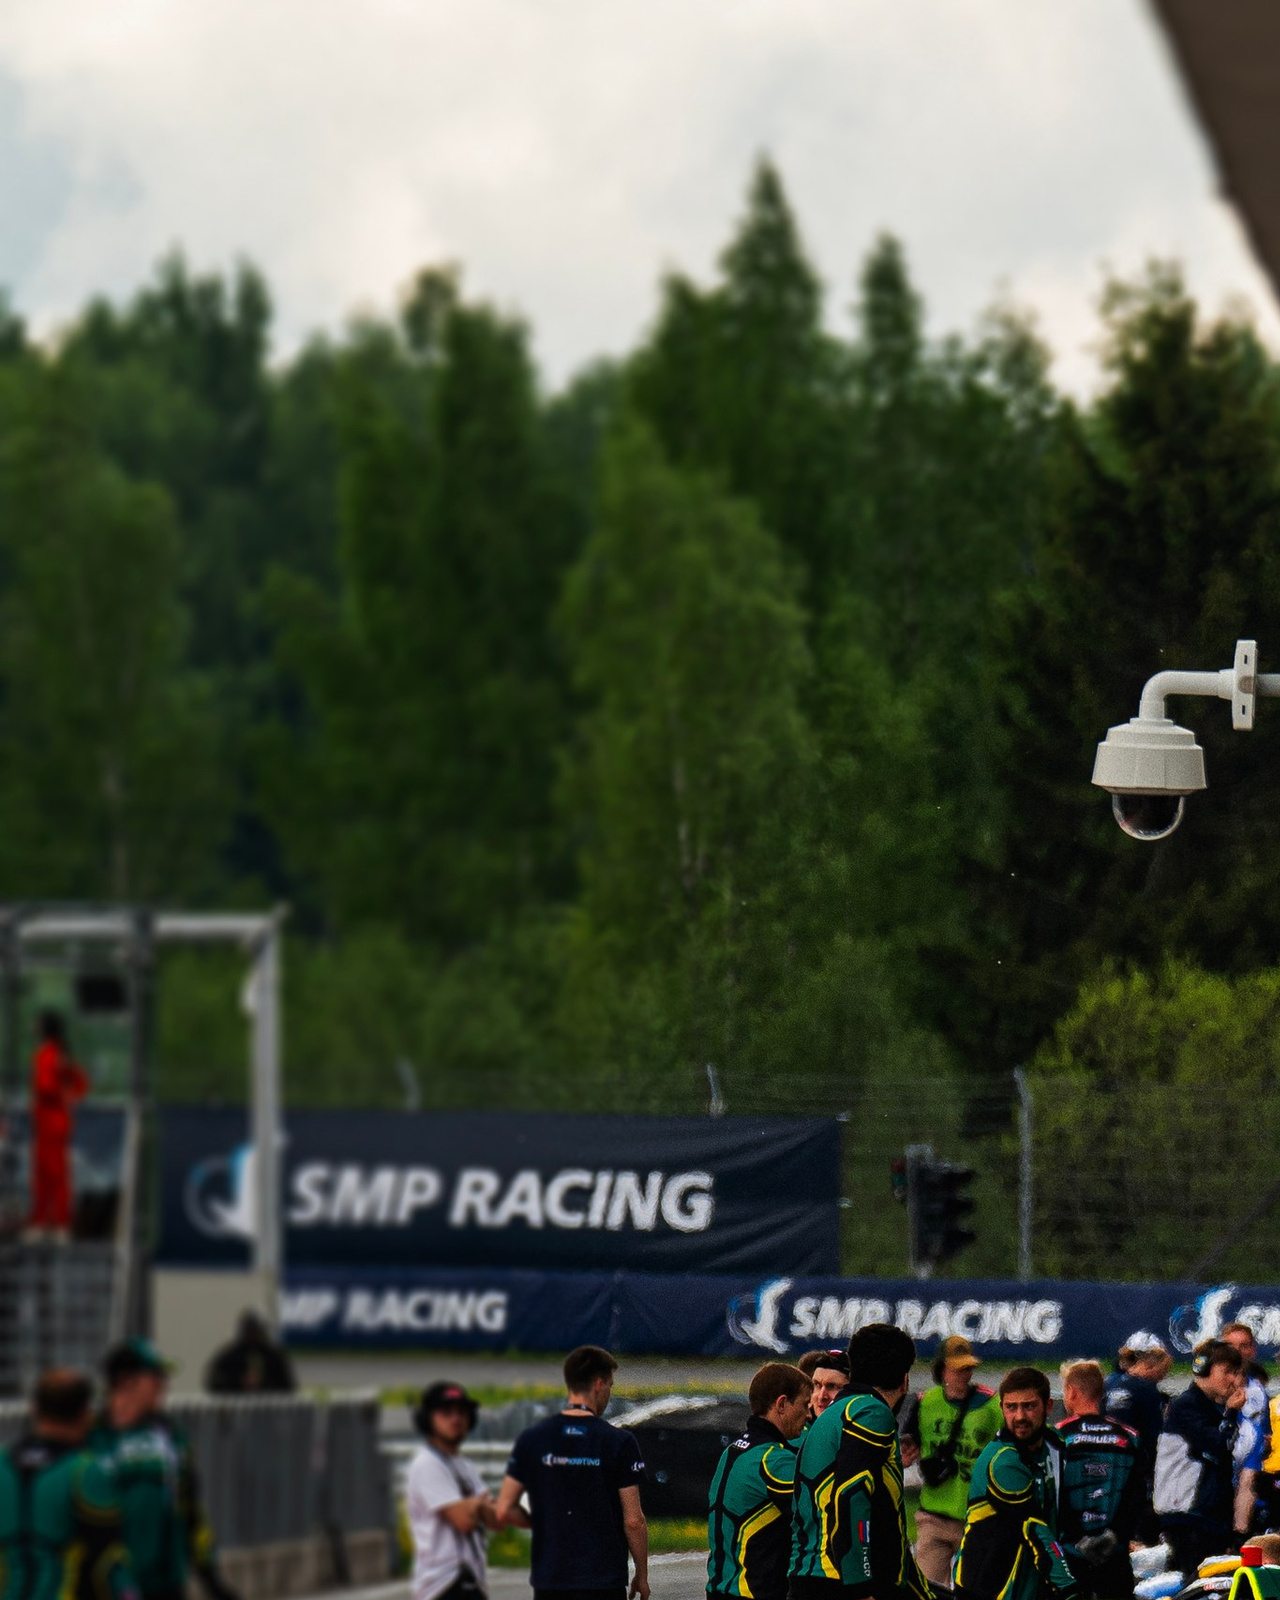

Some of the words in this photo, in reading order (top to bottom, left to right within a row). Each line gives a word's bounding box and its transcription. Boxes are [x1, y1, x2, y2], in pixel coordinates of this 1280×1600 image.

[289, 1163, 441, 1228] SMP
[450, 1168, 715, 1233] RACING
[281, 1291, 338, 1327] MP
[341, 1293, 507, 1332] RACING
[790, 1296, 890, 1338] SMP
[894, 1299, 1063, 1344] RACING
